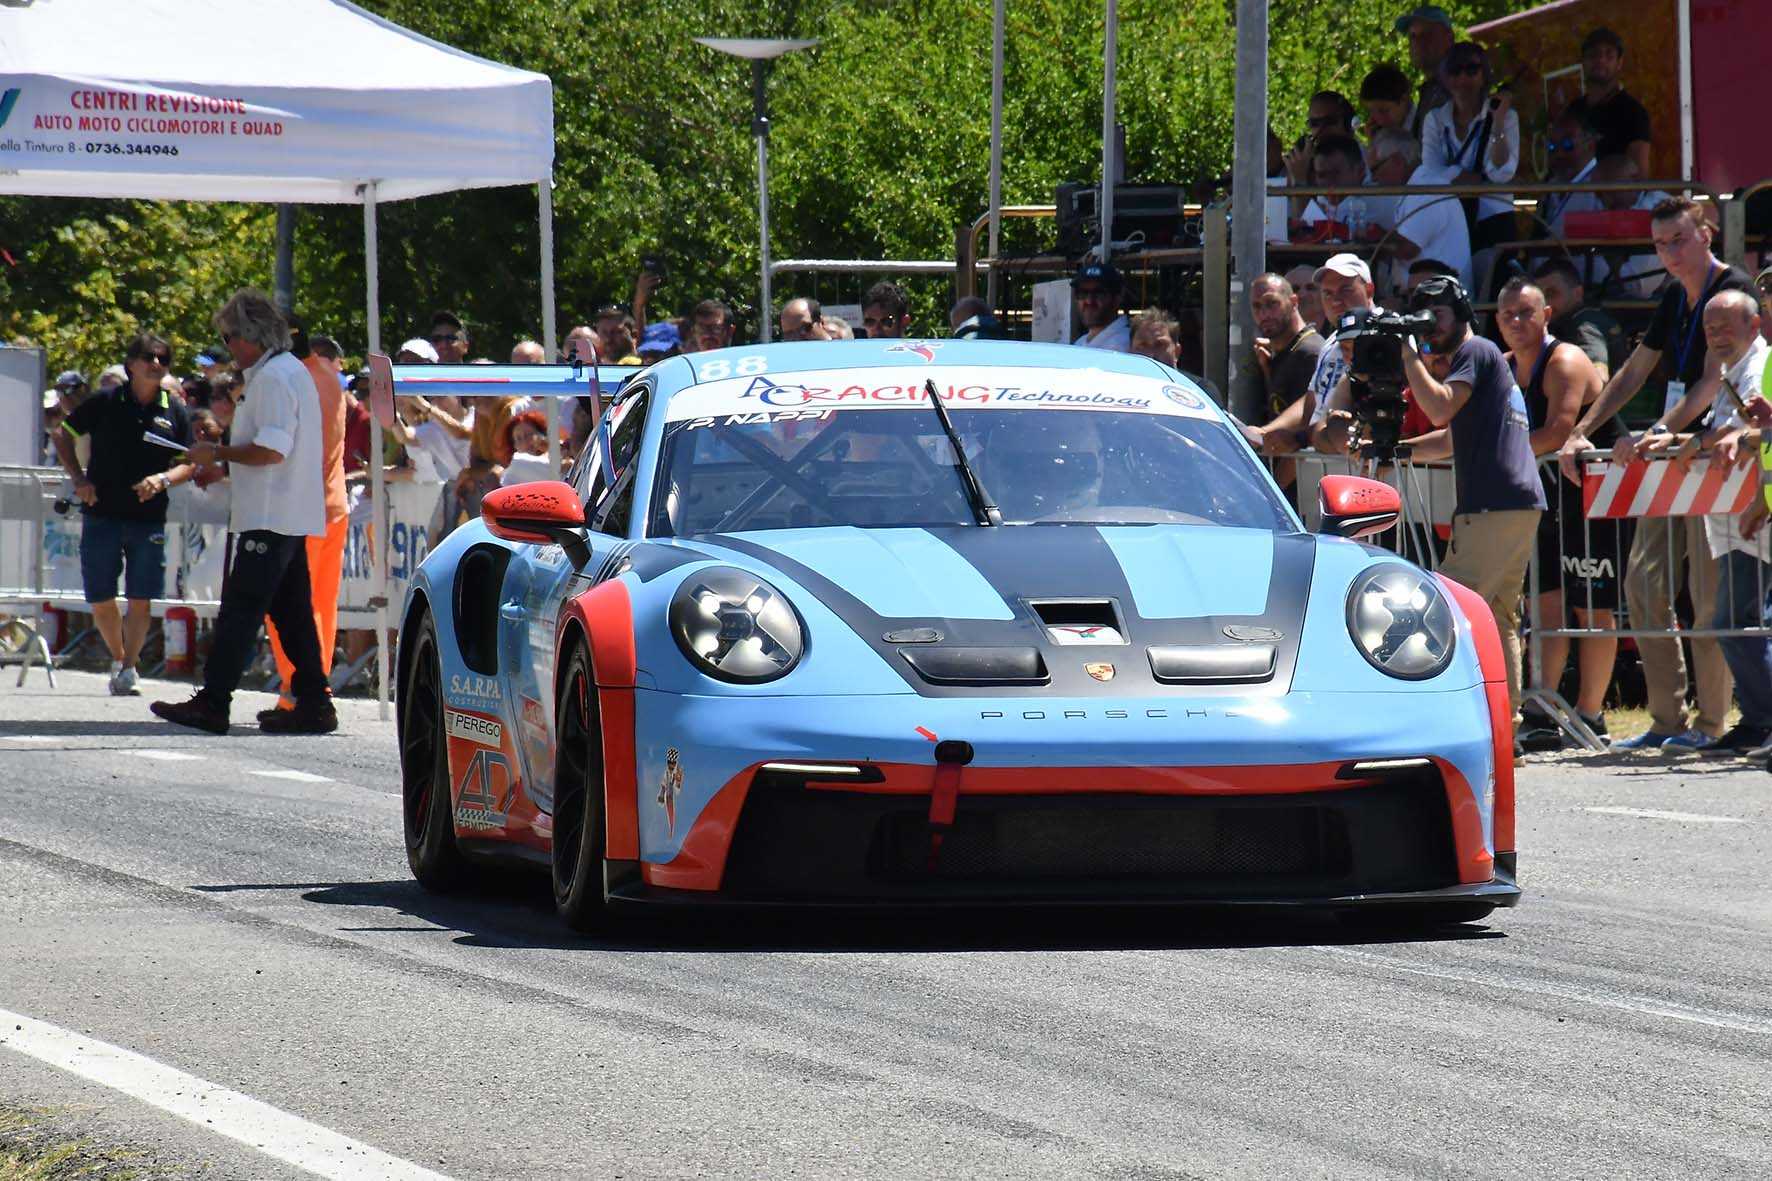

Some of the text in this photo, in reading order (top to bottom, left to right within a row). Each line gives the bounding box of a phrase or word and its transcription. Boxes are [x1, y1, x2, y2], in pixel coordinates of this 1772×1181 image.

[71, 90, 247, 115] CENTRI REVISIONE
[34, 114, 283, 136] AUTO MOTO CICLOMOTORI E QUAD
[24, 139, 64, 152] Tintura
[68, 142, 75, 152] 8
[86, 142, 179, 156] 0736.344946
[700, 356, 768, 381] 88
[995, 387, 1151, 408] Technology
[687, 409, 833, 431] P. NAPPI
[456, 714, 500, 737] PEREGO
